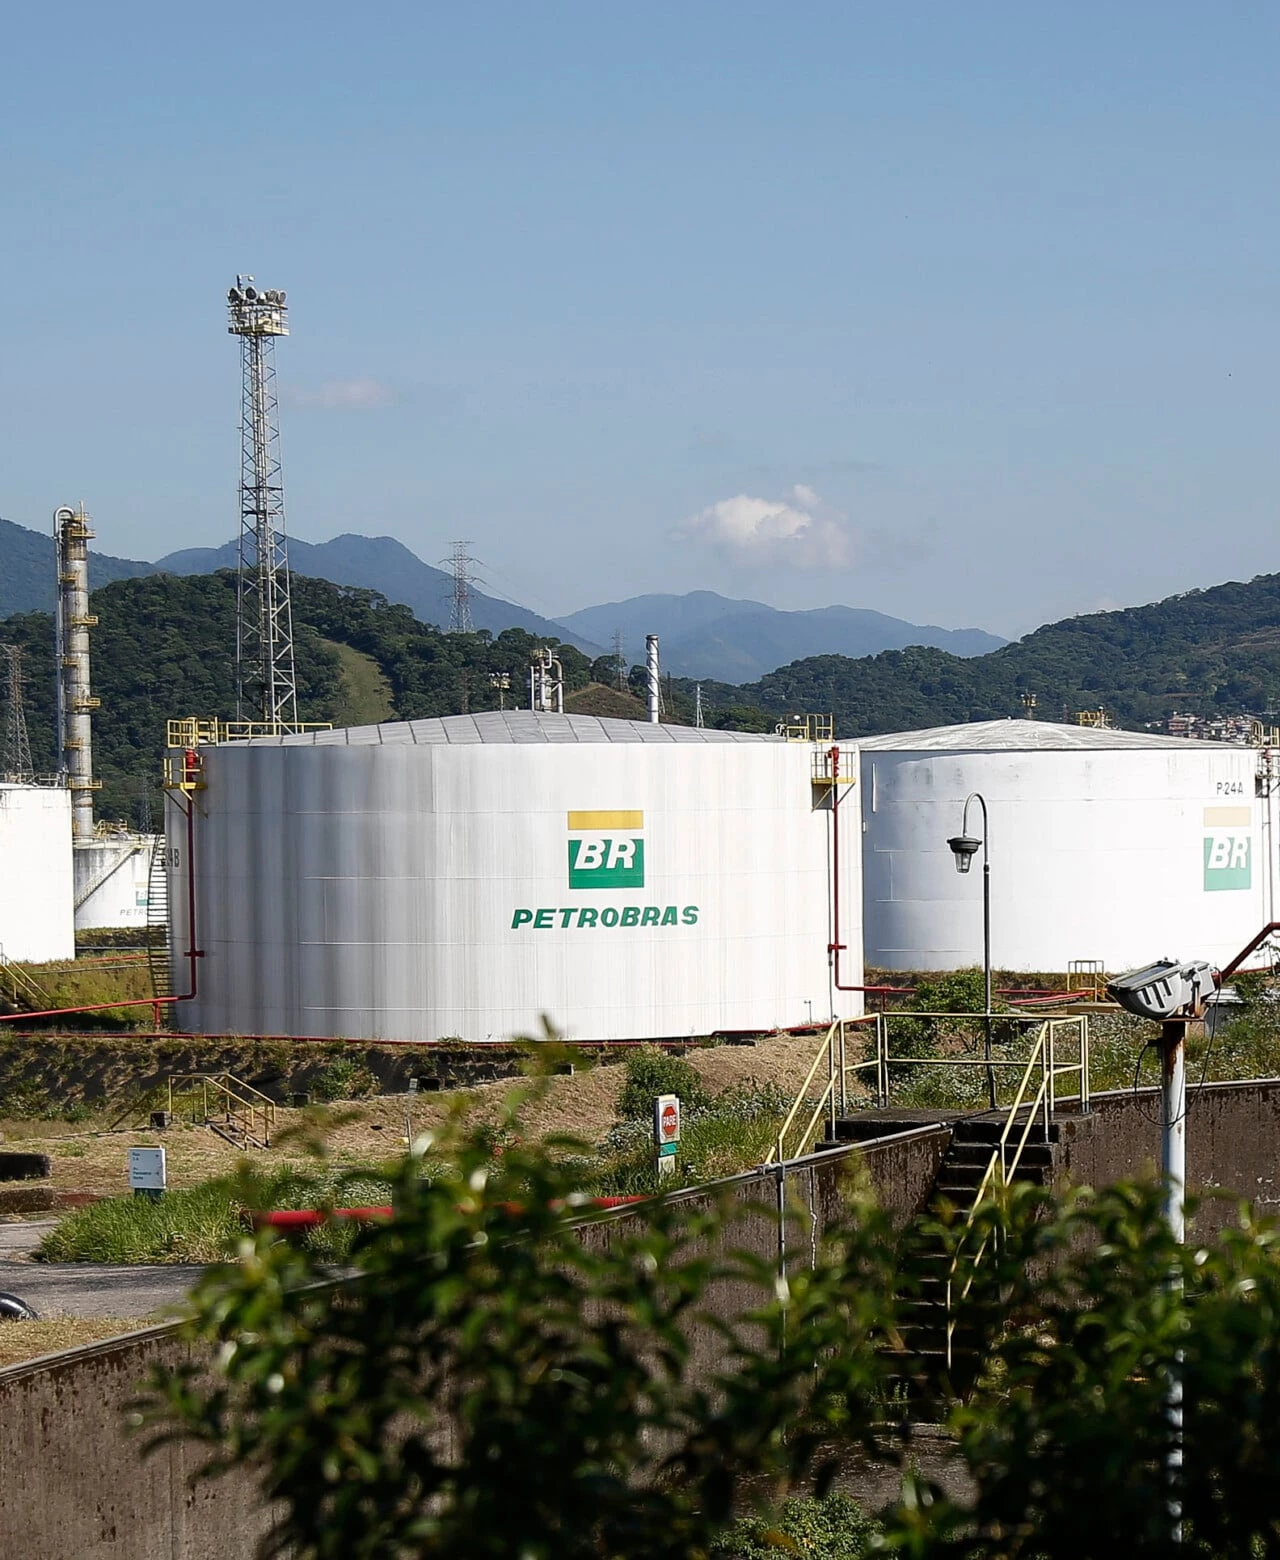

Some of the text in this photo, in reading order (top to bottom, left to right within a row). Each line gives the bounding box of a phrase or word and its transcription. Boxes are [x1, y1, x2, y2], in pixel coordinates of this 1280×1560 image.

[573, 838, 637, 870] BR
[1207, 836, 1249, 869] BR
[510, 905, 700, 930] PETROBRAS
